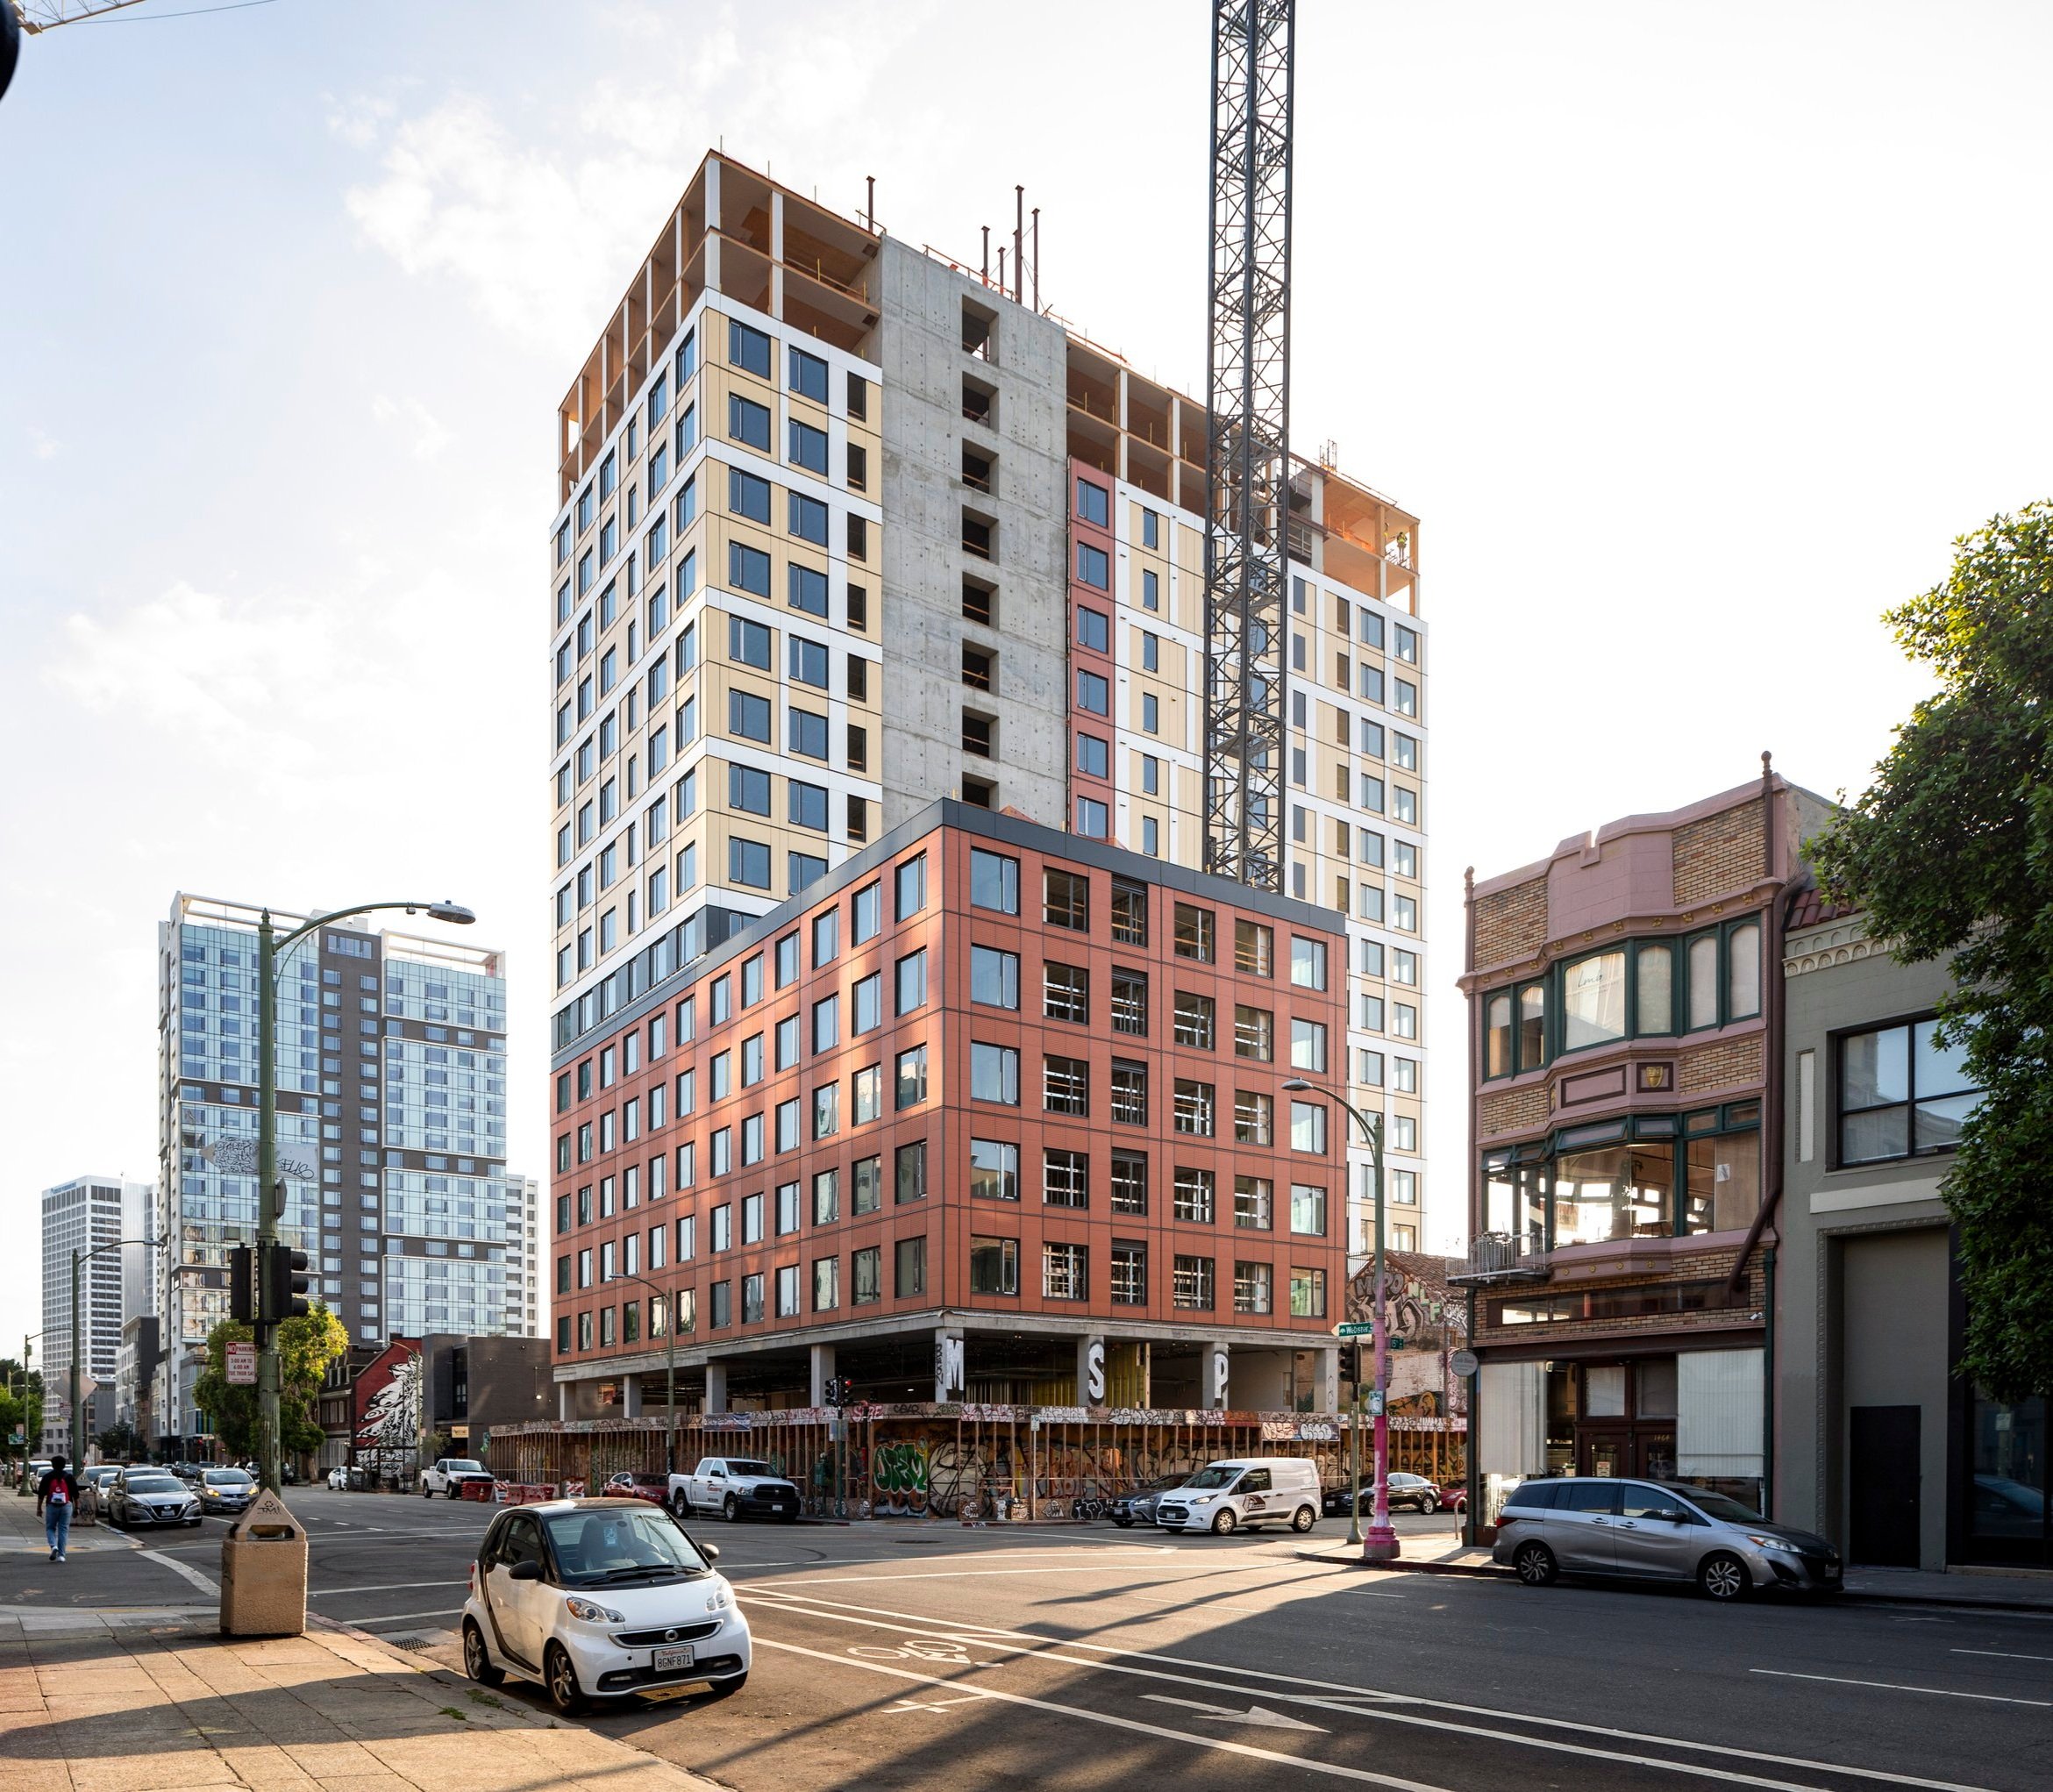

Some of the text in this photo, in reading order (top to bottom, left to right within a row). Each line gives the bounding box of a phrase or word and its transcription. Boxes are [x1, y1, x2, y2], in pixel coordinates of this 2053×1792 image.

[228, 1345, 236, 1353] NO
[946, 1339, 964, 1390] M
[1088, 1343, 1105, 1399] S
[1214, 1353, 1229, 1399] P
[658, 1654, 691, 1668] 8GNF871
